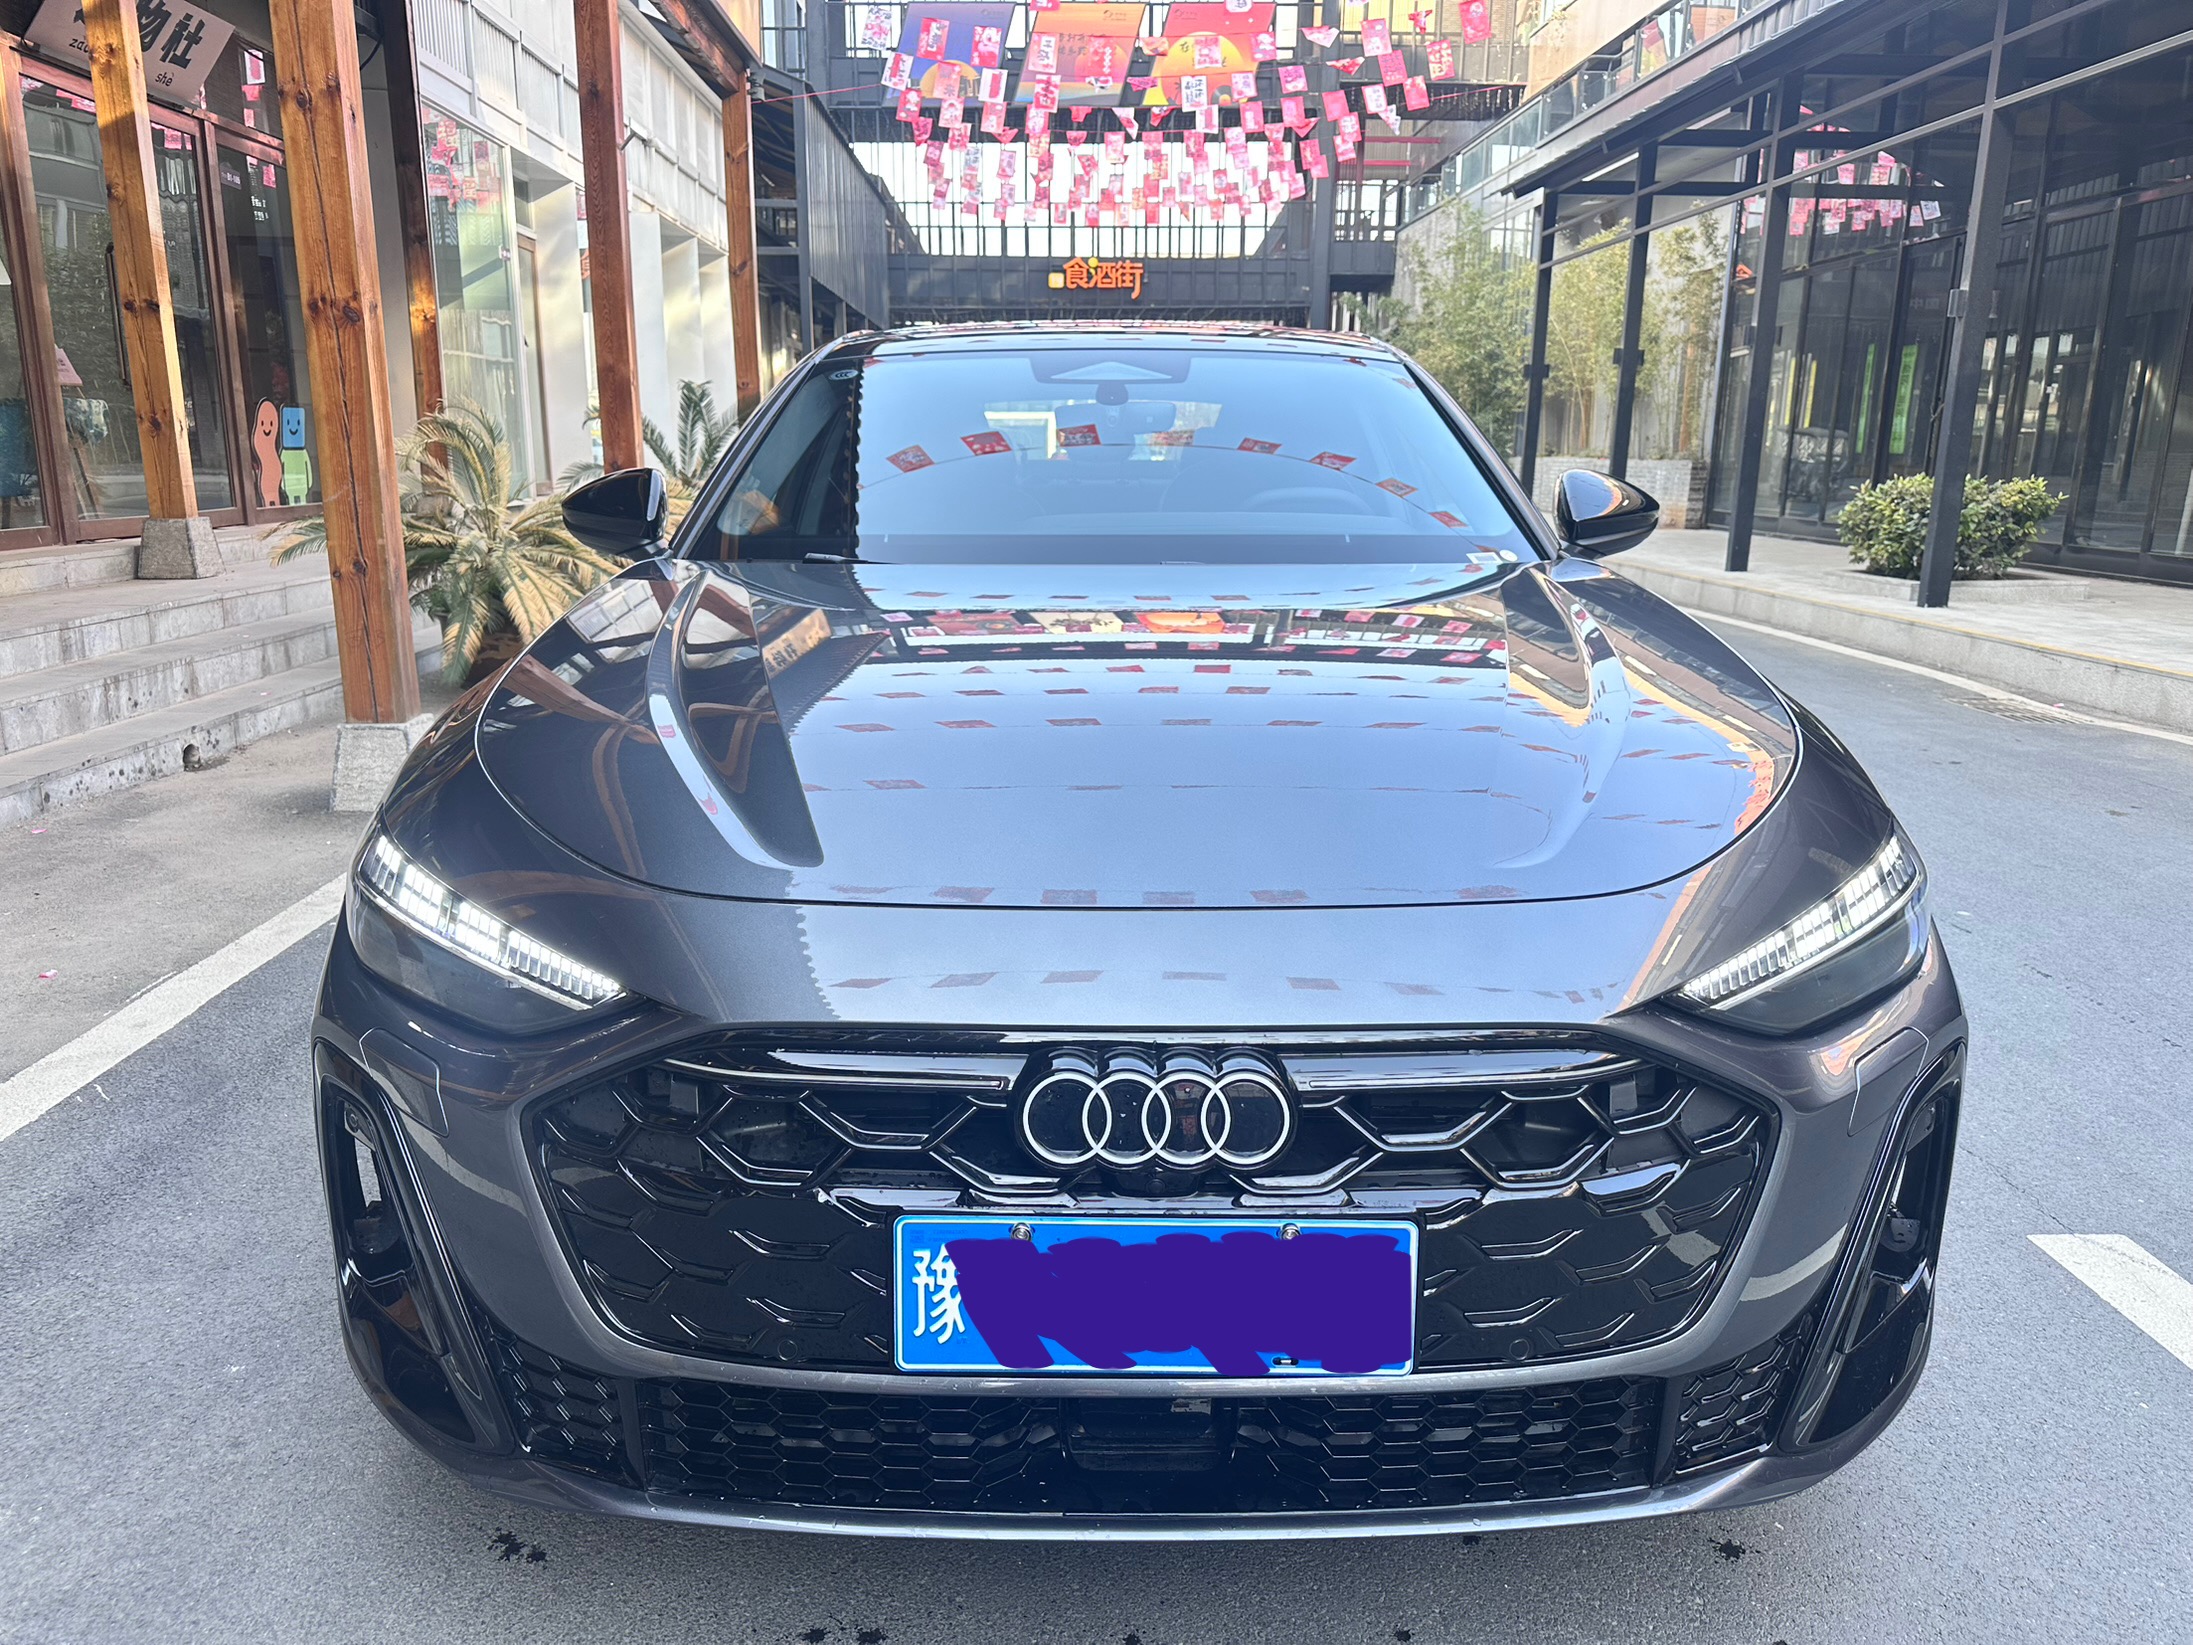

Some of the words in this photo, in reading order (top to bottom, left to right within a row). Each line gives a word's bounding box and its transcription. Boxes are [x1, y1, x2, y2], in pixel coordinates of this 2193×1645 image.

[1062, 256, 1144, 299] 食酒街
[911, 1243, 966, 1344] 豫
